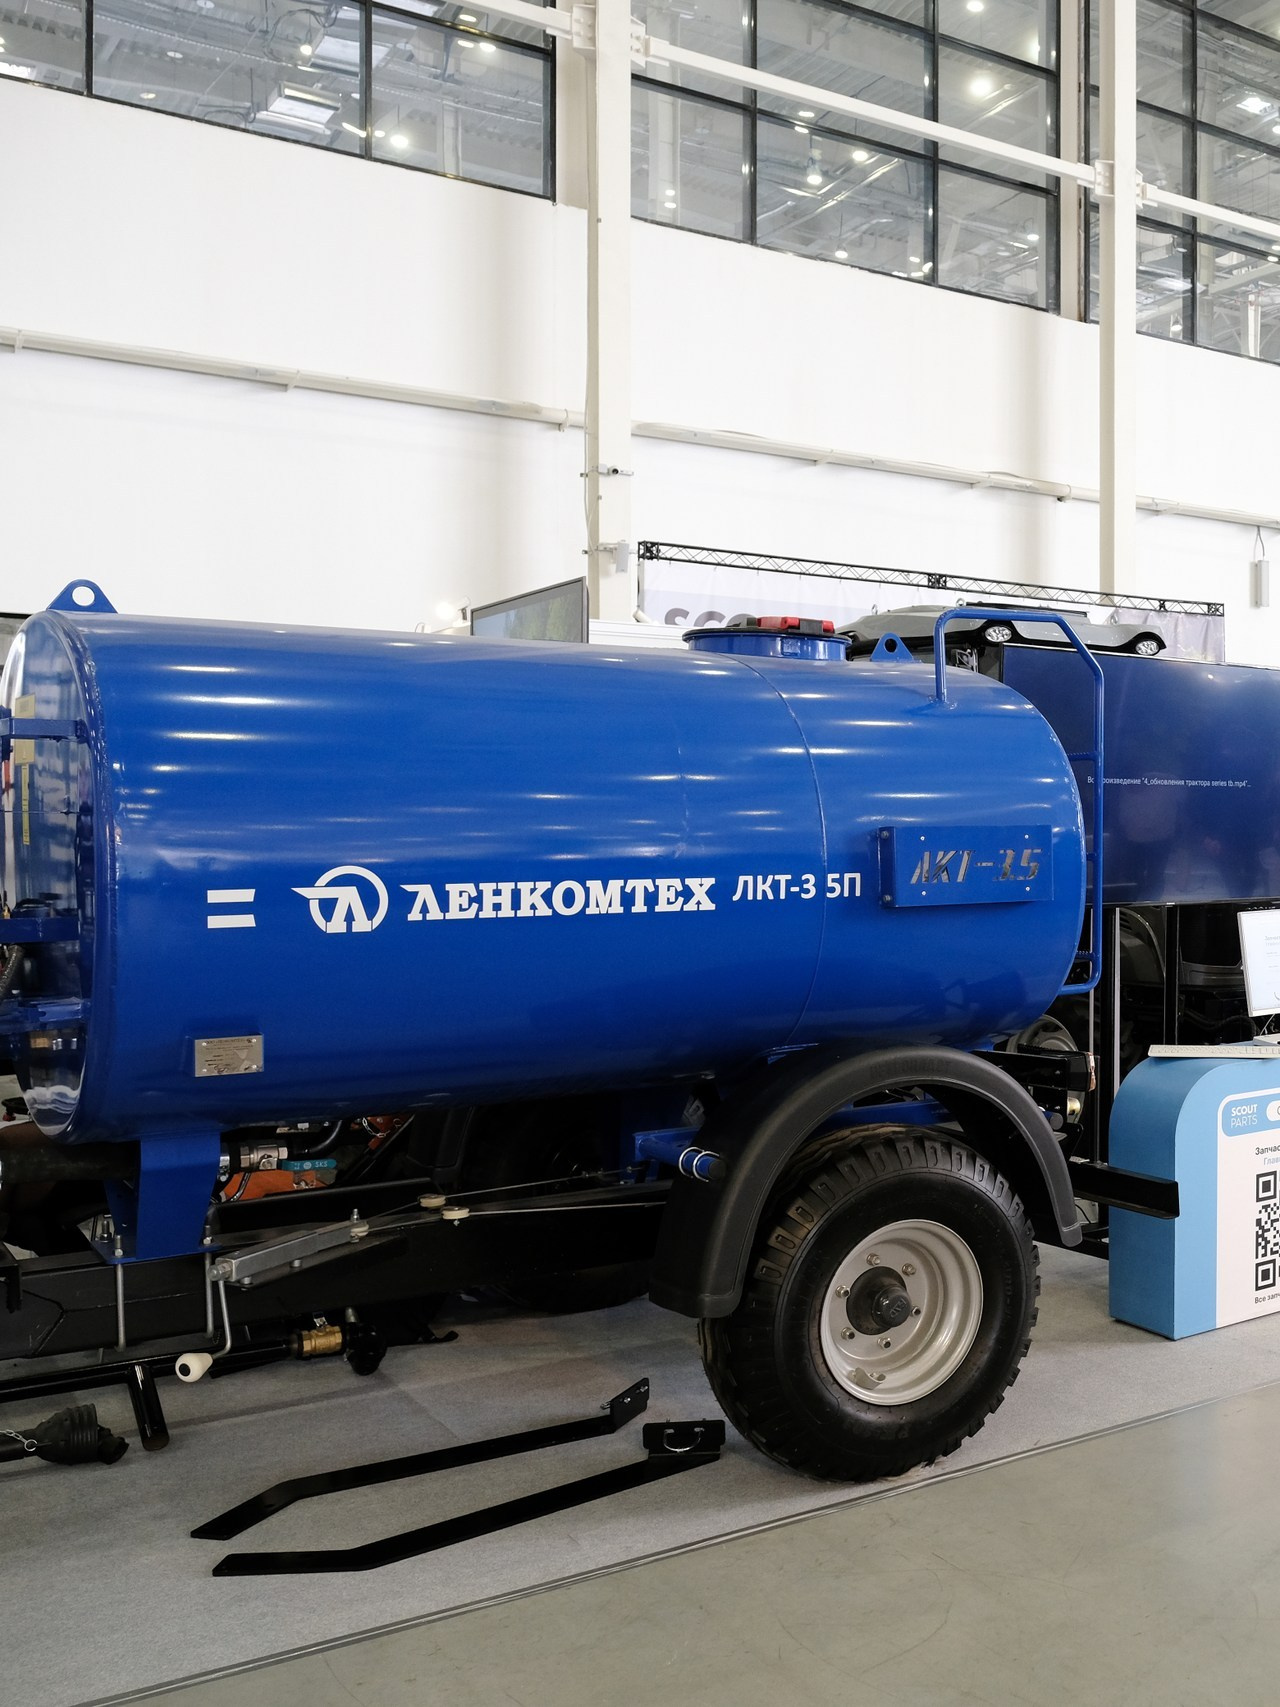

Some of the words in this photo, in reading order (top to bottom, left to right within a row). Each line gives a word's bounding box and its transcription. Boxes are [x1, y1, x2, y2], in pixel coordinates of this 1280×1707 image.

[400, 878, 716, 921] ЛЕНКОМТЕХ
[1231, 1104, 1257, 1117] SCOUT
[1231, 1115, 1257, 1128] PARTS
[1255, 1295, 1266, 1304] Все
